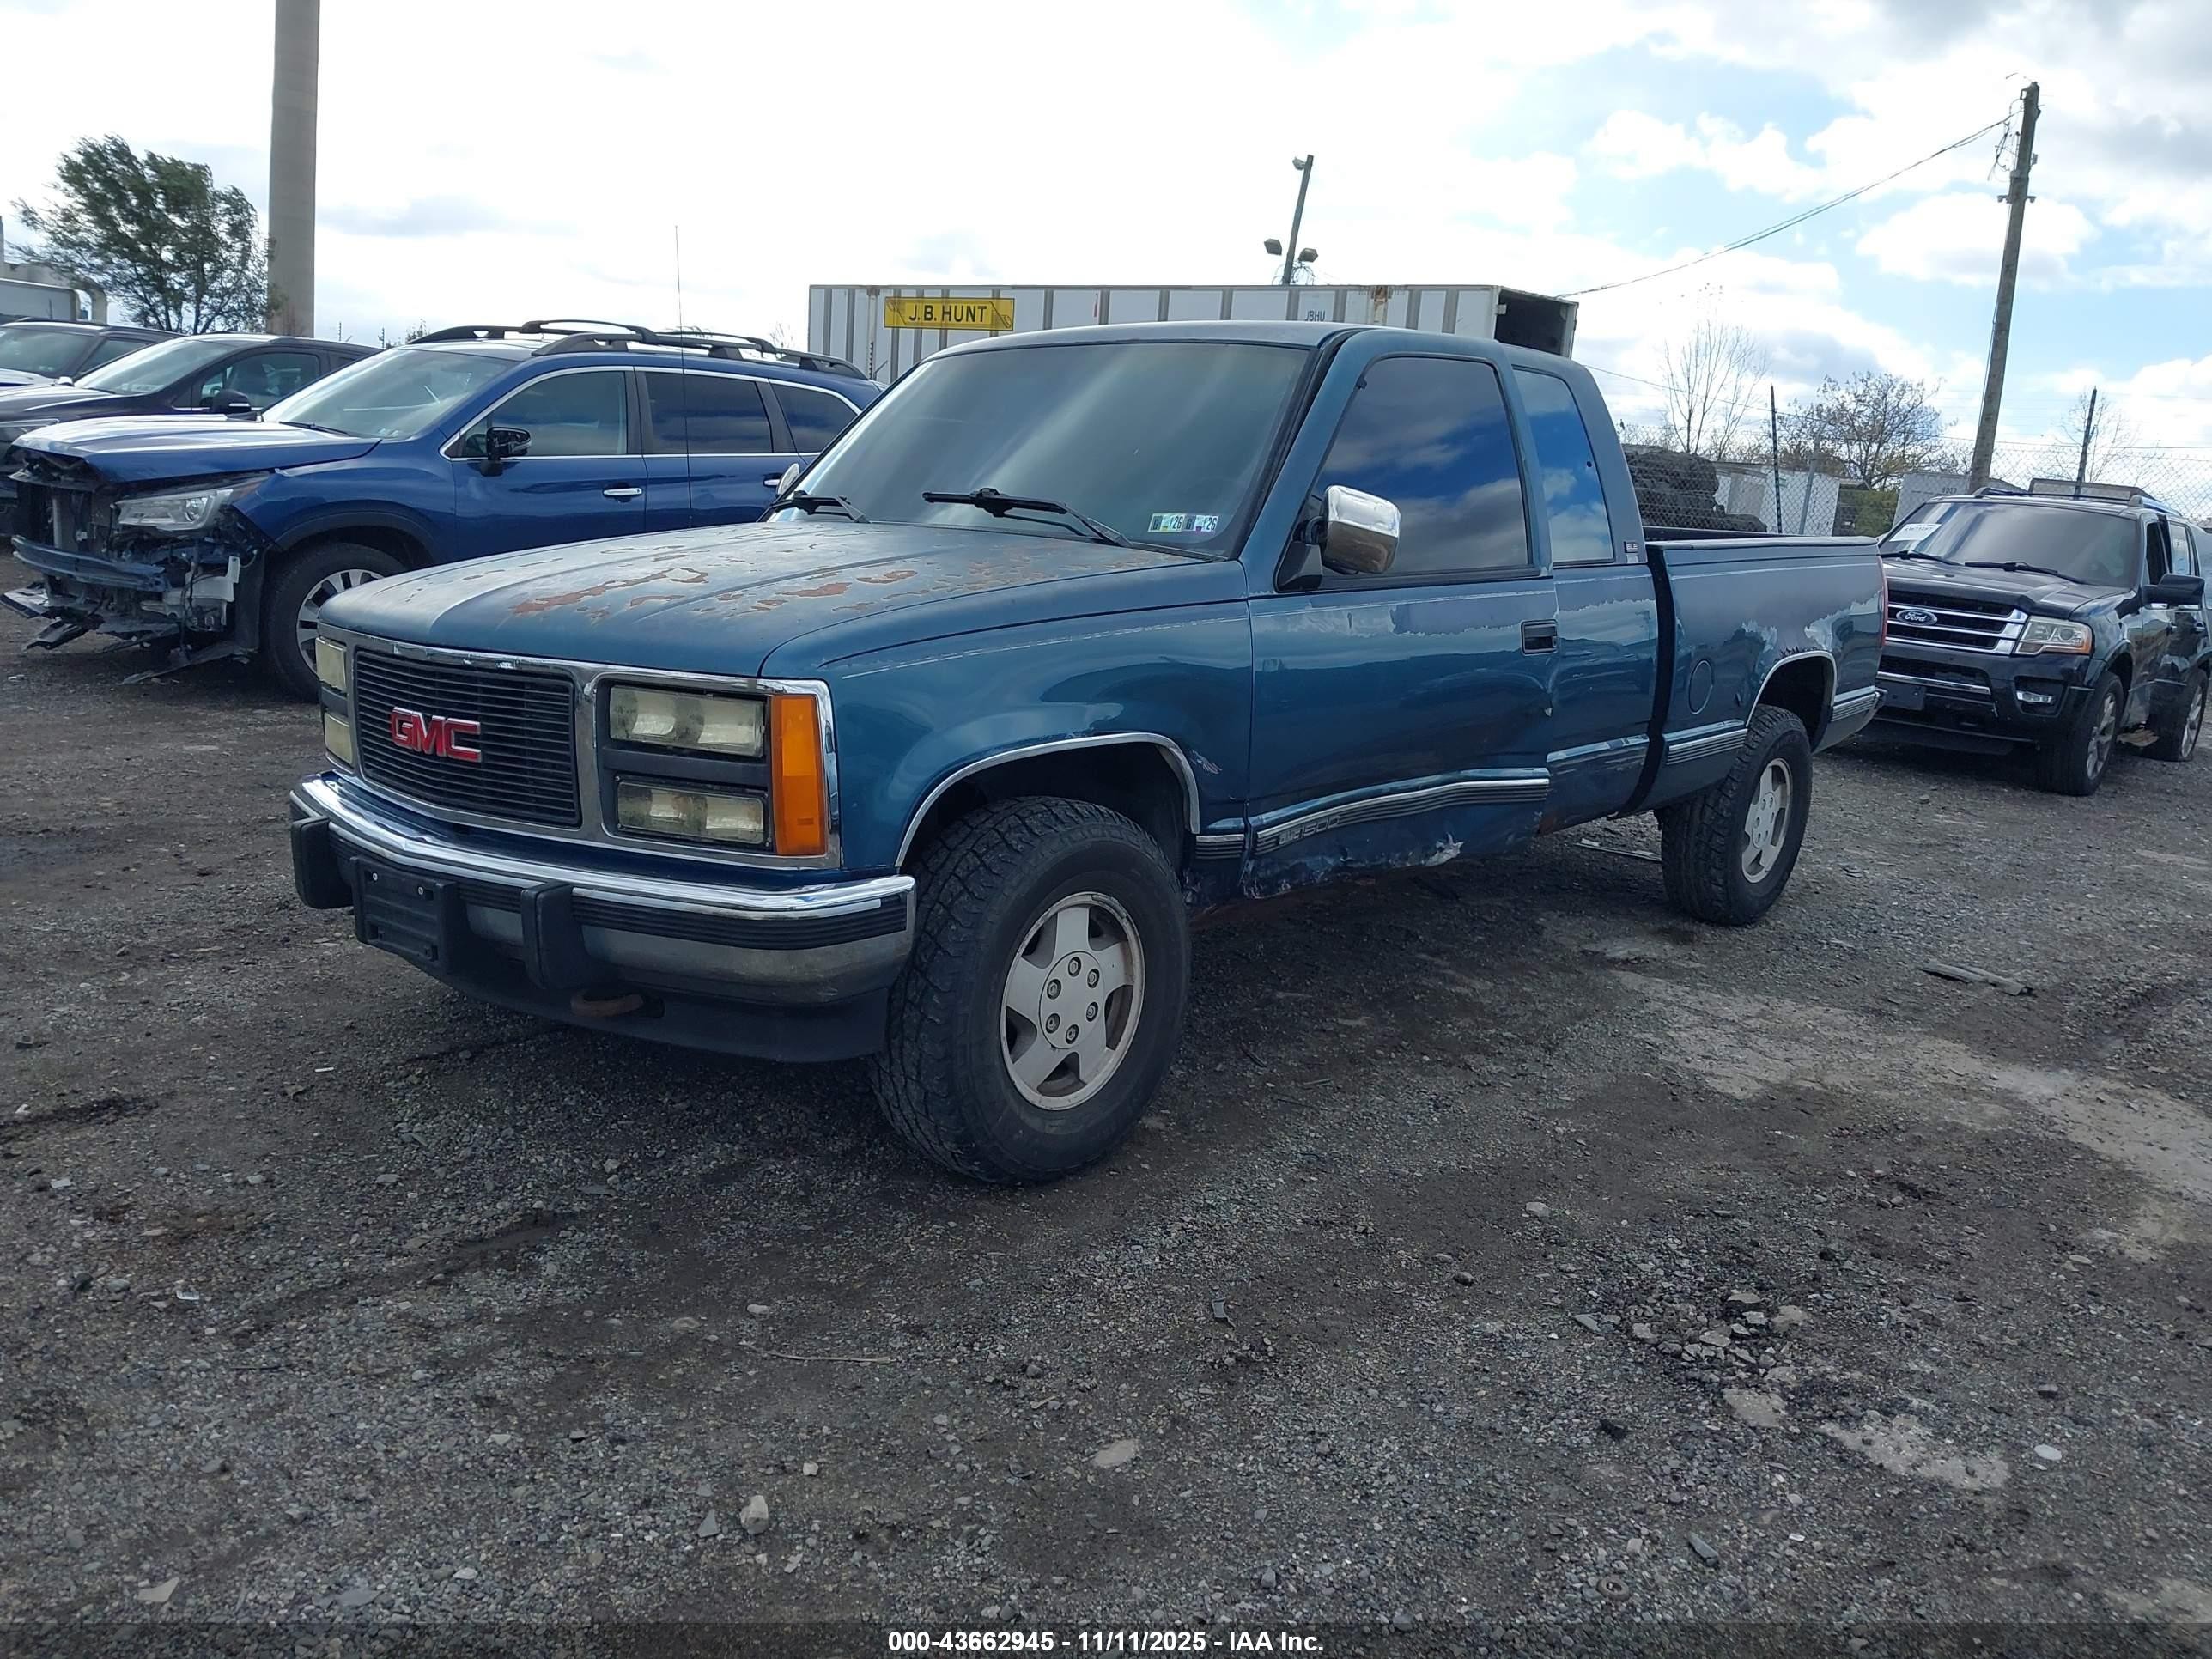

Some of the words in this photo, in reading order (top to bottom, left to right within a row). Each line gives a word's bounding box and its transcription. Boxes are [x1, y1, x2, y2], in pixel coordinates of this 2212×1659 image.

[941, 305, 988, 322] HUNT
[1305, 310, 1326, 322] JBHU
[1904, 611, 1928, 622] Ford
[391, 707, 482, 763] GMC
